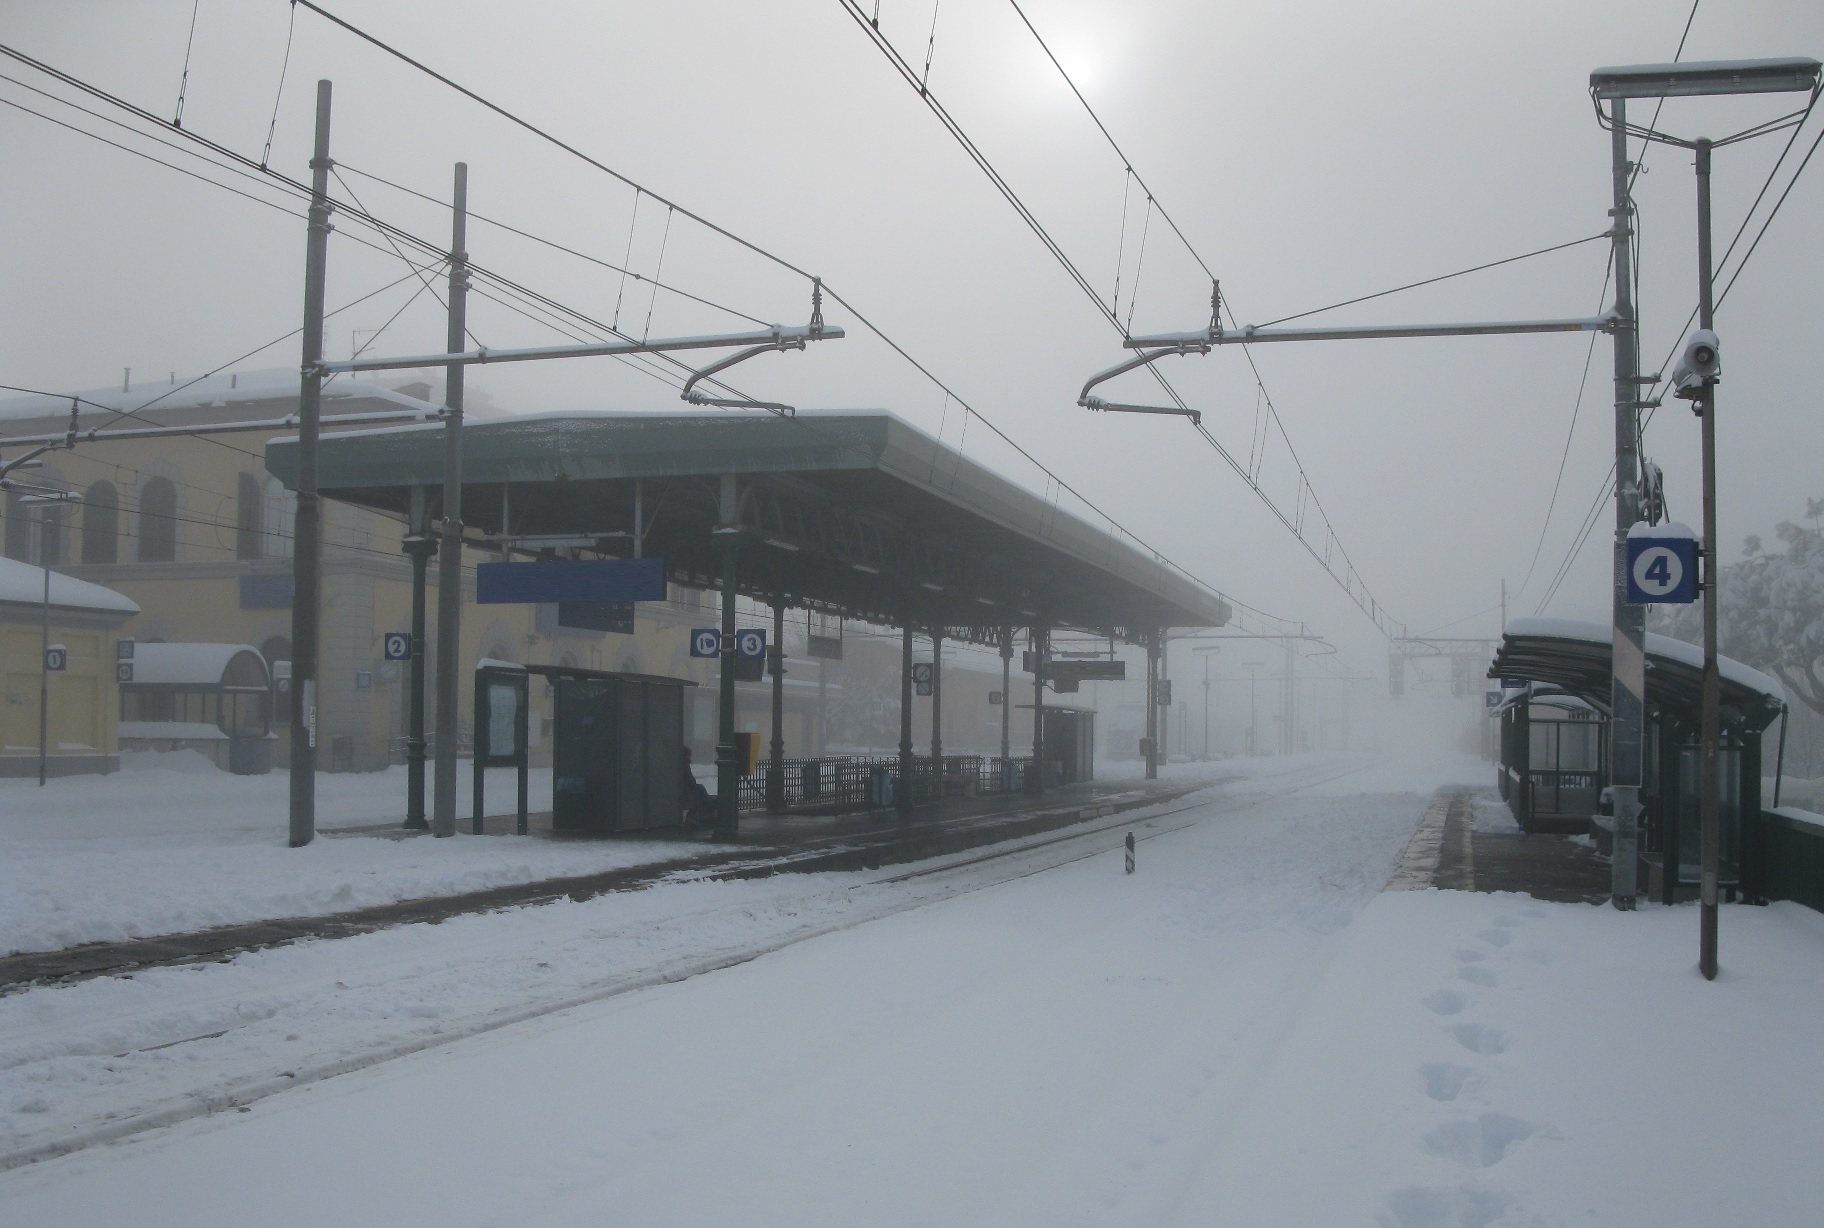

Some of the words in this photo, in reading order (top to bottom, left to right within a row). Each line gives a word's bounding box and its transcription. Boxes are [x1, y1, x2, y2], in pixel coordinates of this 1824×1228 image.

[1645, 556, 1671, 586] 4
[392, 639, 401, 654] 2
[746, 637, 757, 651] 3
